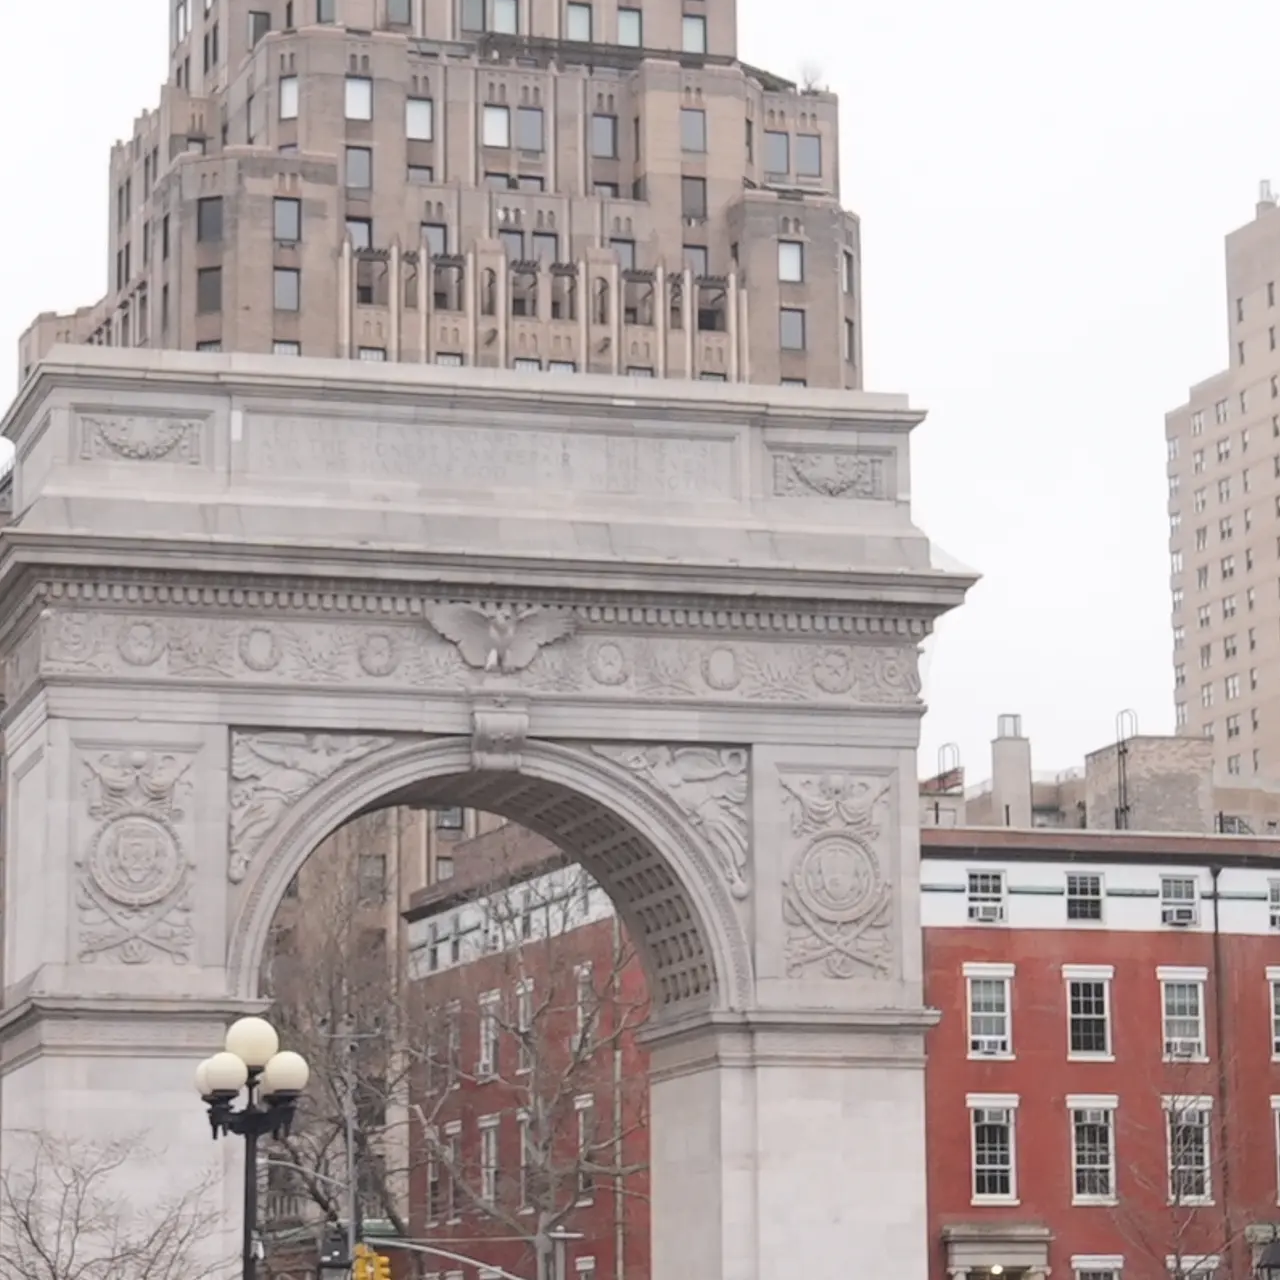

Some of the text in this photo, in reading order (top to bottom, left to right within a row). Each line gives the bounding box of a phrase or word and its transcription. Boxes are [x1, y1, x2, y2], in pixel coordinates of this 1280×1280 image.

[308, 439, 347, 457] THE
[358, 441, 439, 461] HONEST
[503, 448, 571, 468] REPAIR
[463, 464, 508, 481] GOD
[587, 471, 725, 494] WASHNGTON
